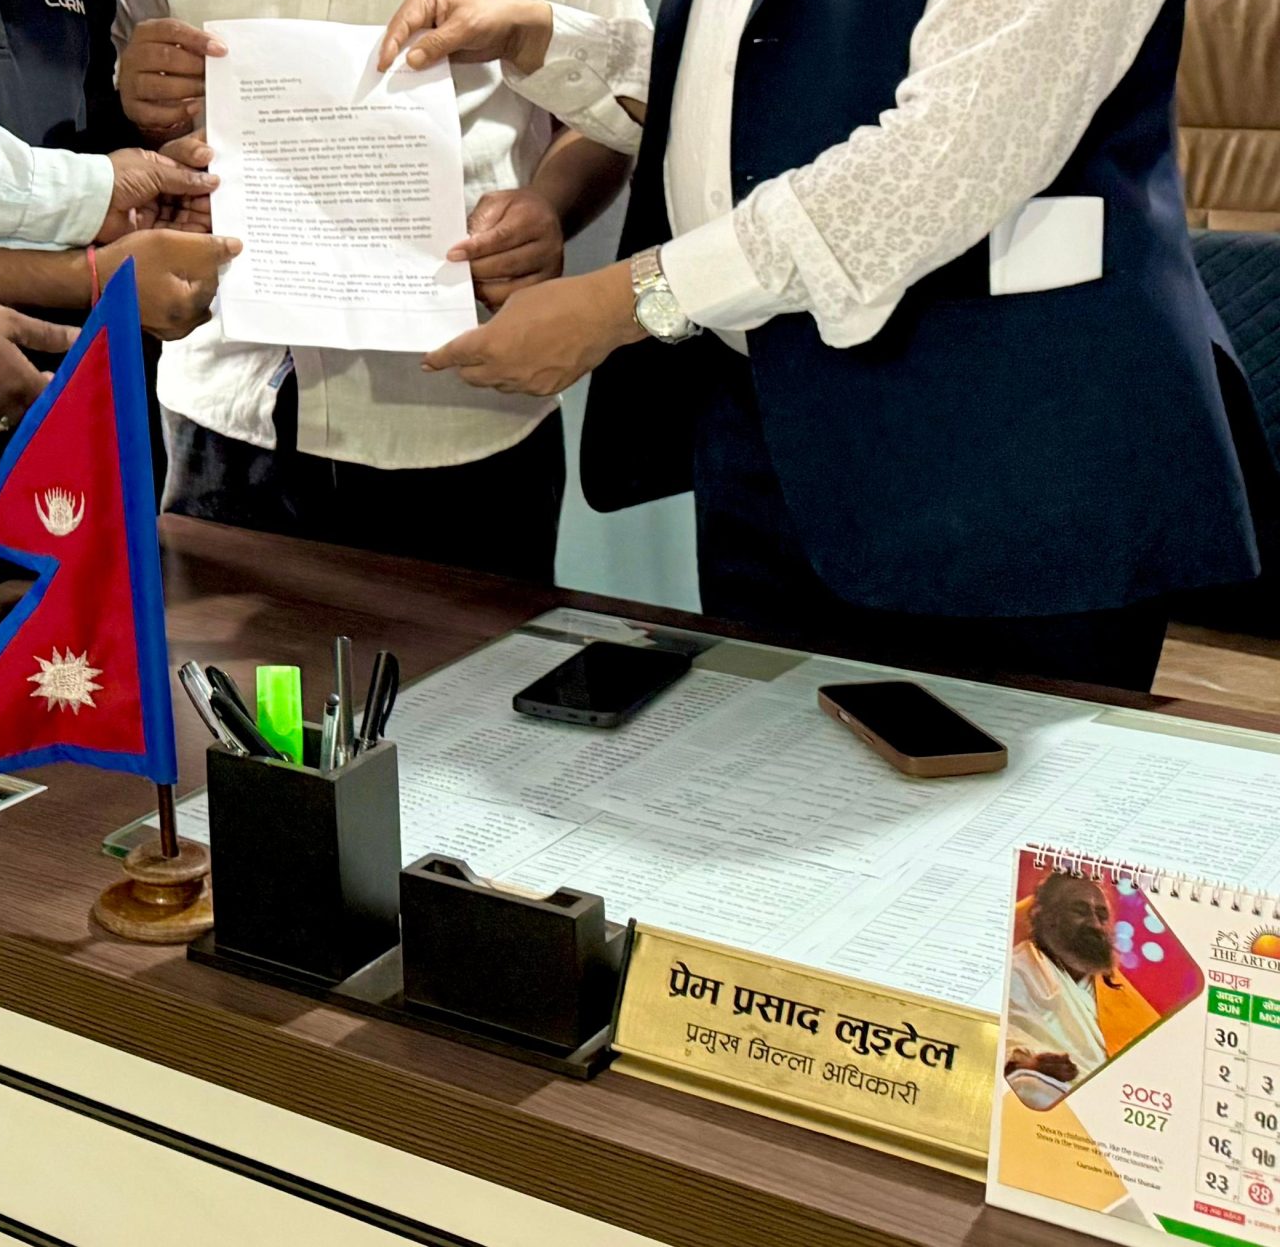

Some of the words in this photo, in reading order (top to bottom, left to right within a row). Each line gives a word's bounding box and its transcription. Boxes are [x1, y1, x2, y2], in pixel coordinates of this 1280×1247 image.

[1211, 947, 1237, 962] THE
[1240, 954, 1266, 968] ART
[1208, 969, 1253, 991] फागुन
[668, 961, 724, 1006] प्रेम
[733, 985, 825, 1034] प्रसाद
[834, 1012, 960, 1071] लुइटेल
[1217, 1002, 1241, 1016] SUN
[1214, 1028, 1239, 1048] ३०
[685, 1022, 742, 1053] प्रमुख
[747, 1037, 816, 1076] जिल्ला
[822, 1061, 921, 1106] अधिकारी
[1219, 1065, 1231, 1083] २
[1261, 1075, 1274, 1095] ३
[1122, 1083, 1173, 1111] २०८३
[1124, 1107, 1169, 1133] 2027
[1254, 1110, 1278, 1131] १०
[1208, 1135, 1232, 1159] १६
[1251, 1147, 1276, 1168] १७
[1205, 1171, 1229, 1195] २३
